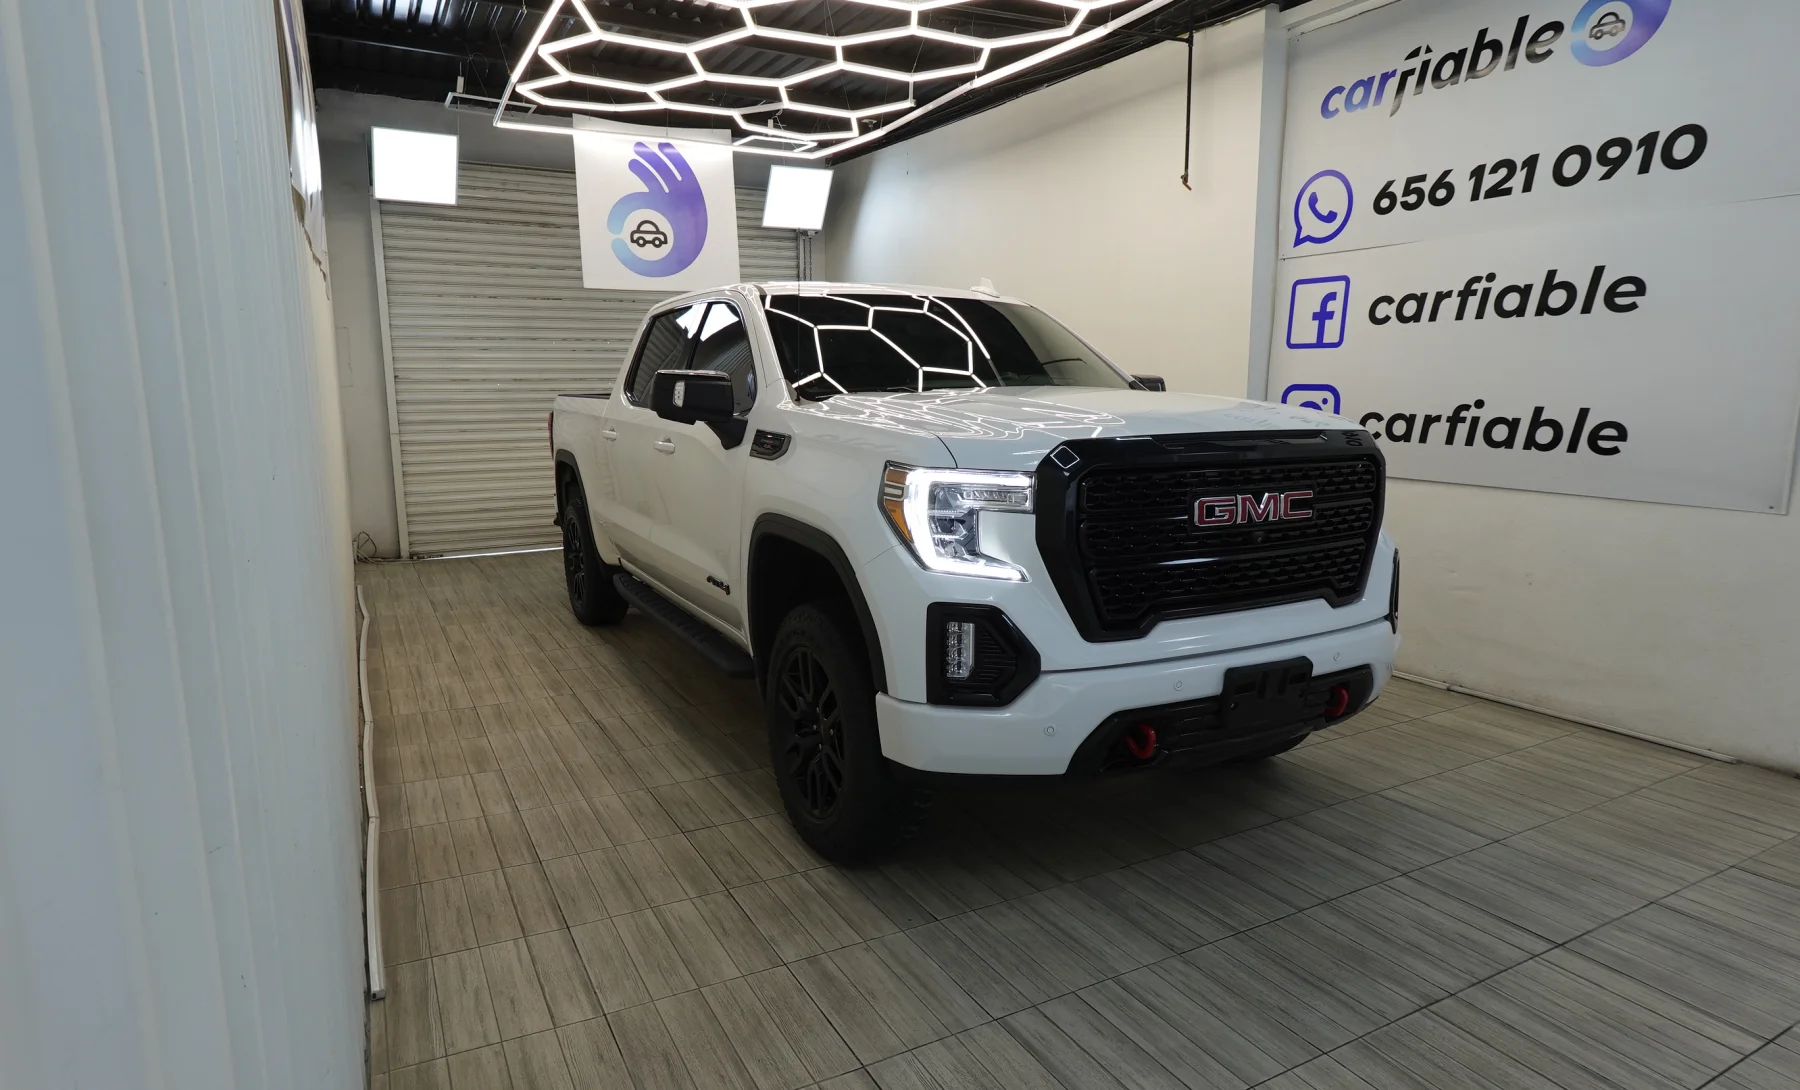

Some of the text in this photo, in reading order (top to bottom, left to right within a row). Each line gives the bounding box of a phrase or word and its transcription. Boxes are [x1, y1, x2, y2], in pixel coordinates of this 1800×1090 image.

[1320, 15, 1565, 119] carfiable
[1372, 123, 1708, 216] 656 121 0910
[1368, 265, 1647, 326] carfiable
[1359, 399, 1629, 457] carfiable
[1194, 490, 1313, 526] GMC
